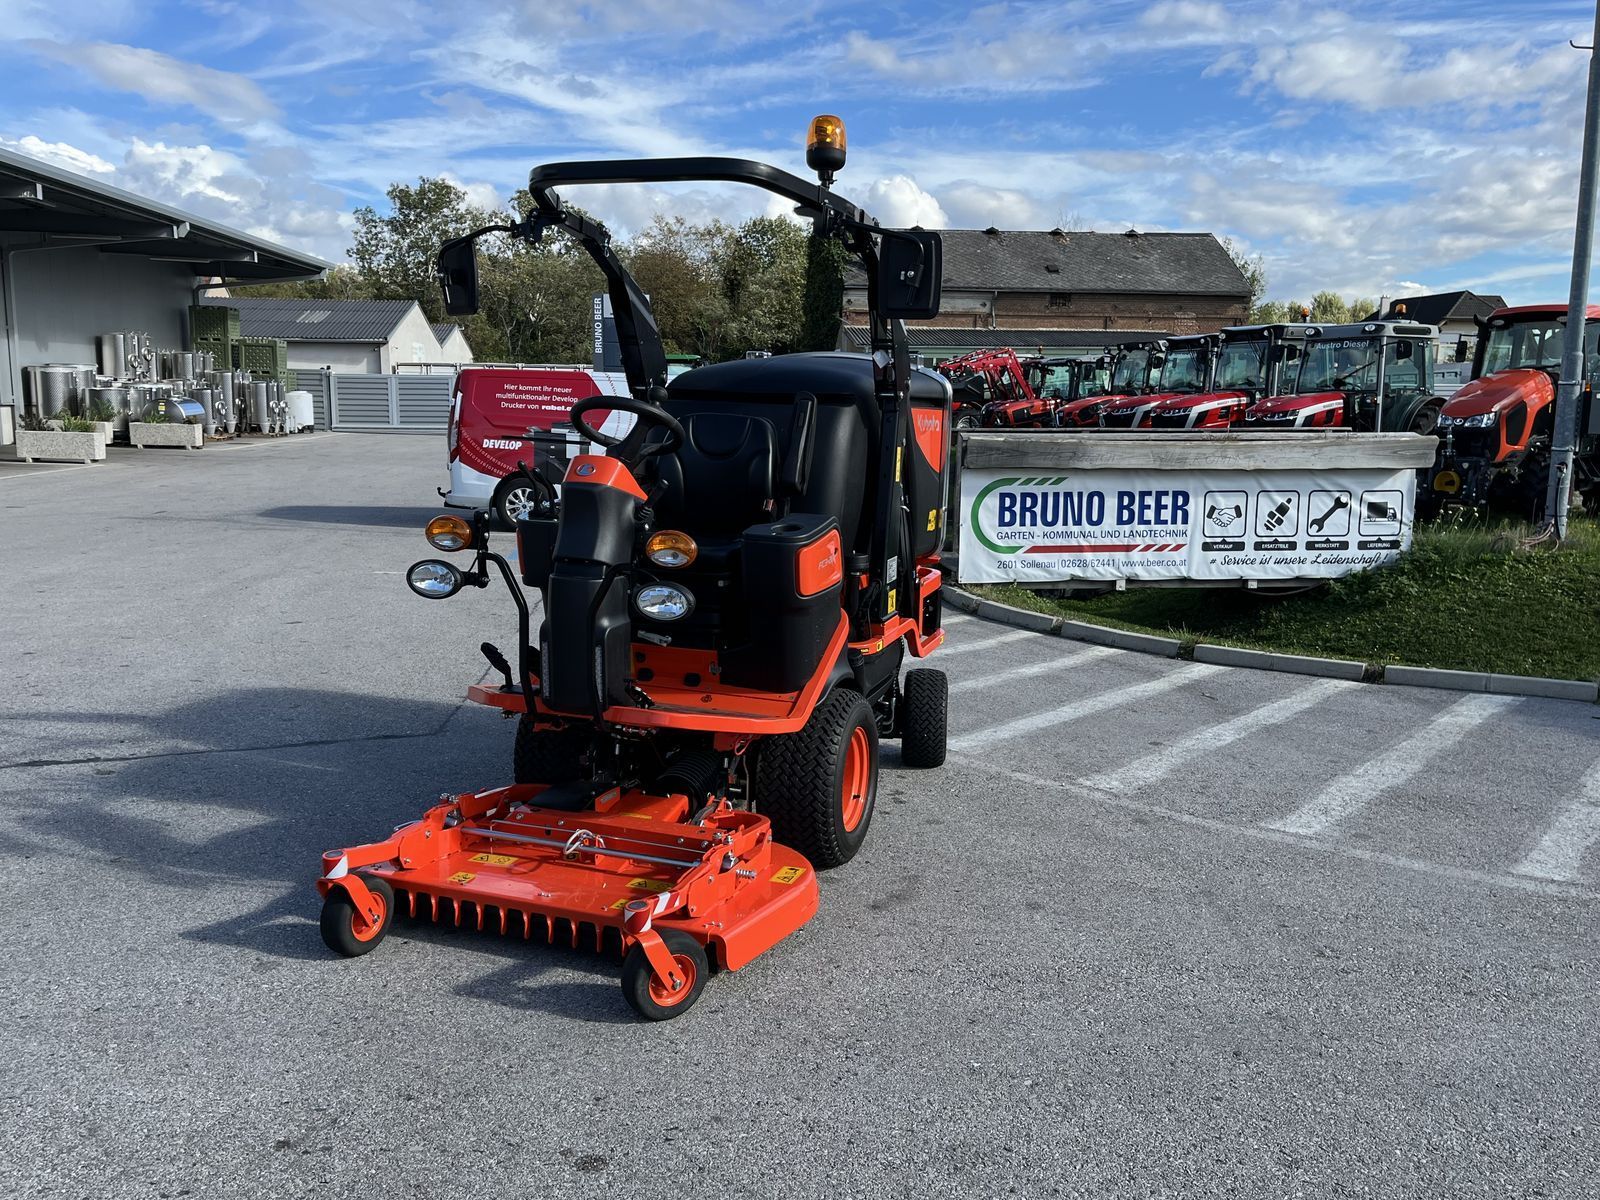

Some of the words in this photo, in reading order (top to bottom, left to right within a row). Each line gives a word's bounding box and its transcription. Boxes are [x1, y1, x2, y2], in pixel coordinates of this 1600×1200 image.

[593, 297, 602, 320] BEER
[594, 321, 603, 354] BRUNO
[1315, 342, 1342, 350] Austro
[1342, 340, 1370, 348] Diesel
[495, 393, 551, 401] multifunktionaler
[552, 395, 578, 403] Develop
[501, 401, 526, 409] Drucker
[482, 439, 522, 450] DEVELOP
[997, 491, 1105, 527] BRUNO
[1116, 490, 1190, 526] BEER
[996, 531, 1035, 540] GARTEN
[1042, 530, 1098, 540] KOMMUNAL
[1100, 530, 1121, 539] UND
[1123, 529, 1188, 538] LANDTECHNIK
[997, 560, 1017, 569] 2601
[1020, 560, 1056, 569] Sollenau
[1060, 559, 1115, 569] 02628/62441
[1121, 558, 1187, 568] www.beer.co.at
[1220, 554, 1257, 566] Service
[1259, 555, 1271, 565] ist
[1273, 556, 1308, 565] unsere
